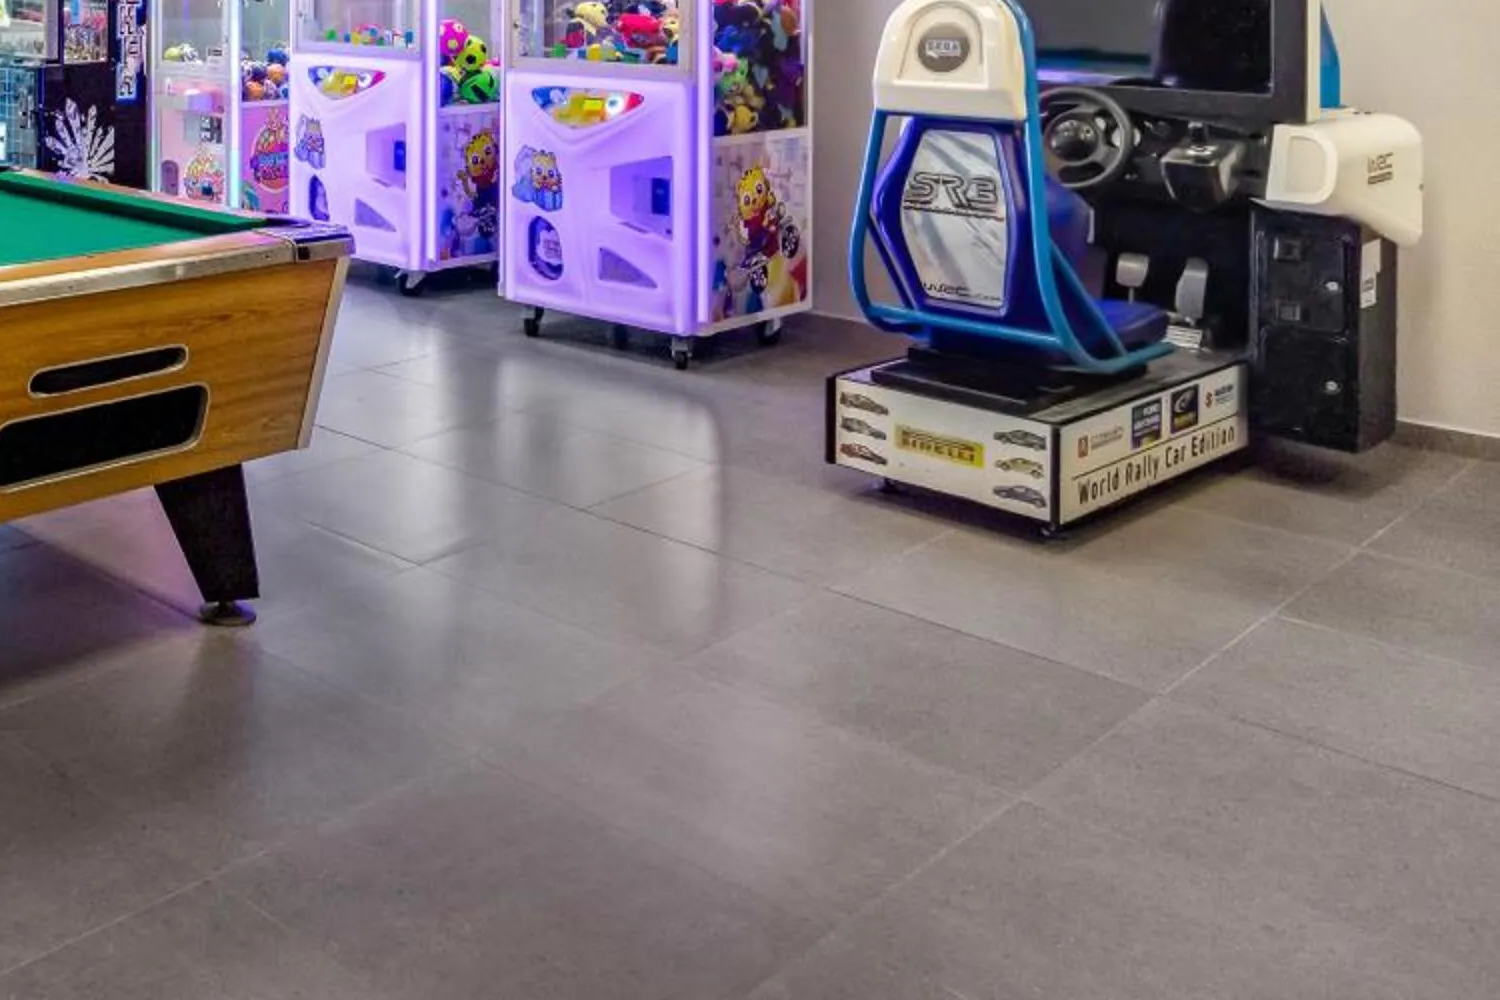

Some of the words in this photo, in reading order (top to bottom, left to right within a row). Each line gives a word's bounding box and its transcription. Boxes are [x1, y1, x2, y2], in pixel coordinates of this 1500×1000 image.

[903, 171, 999, 212] SR3
[1077, 468, 1120, 504] World
[1125, 454, 1160, 486] Rally
[1165, 445, 1187, 469] Car
[1191, 425, 1236, 458] Edition
